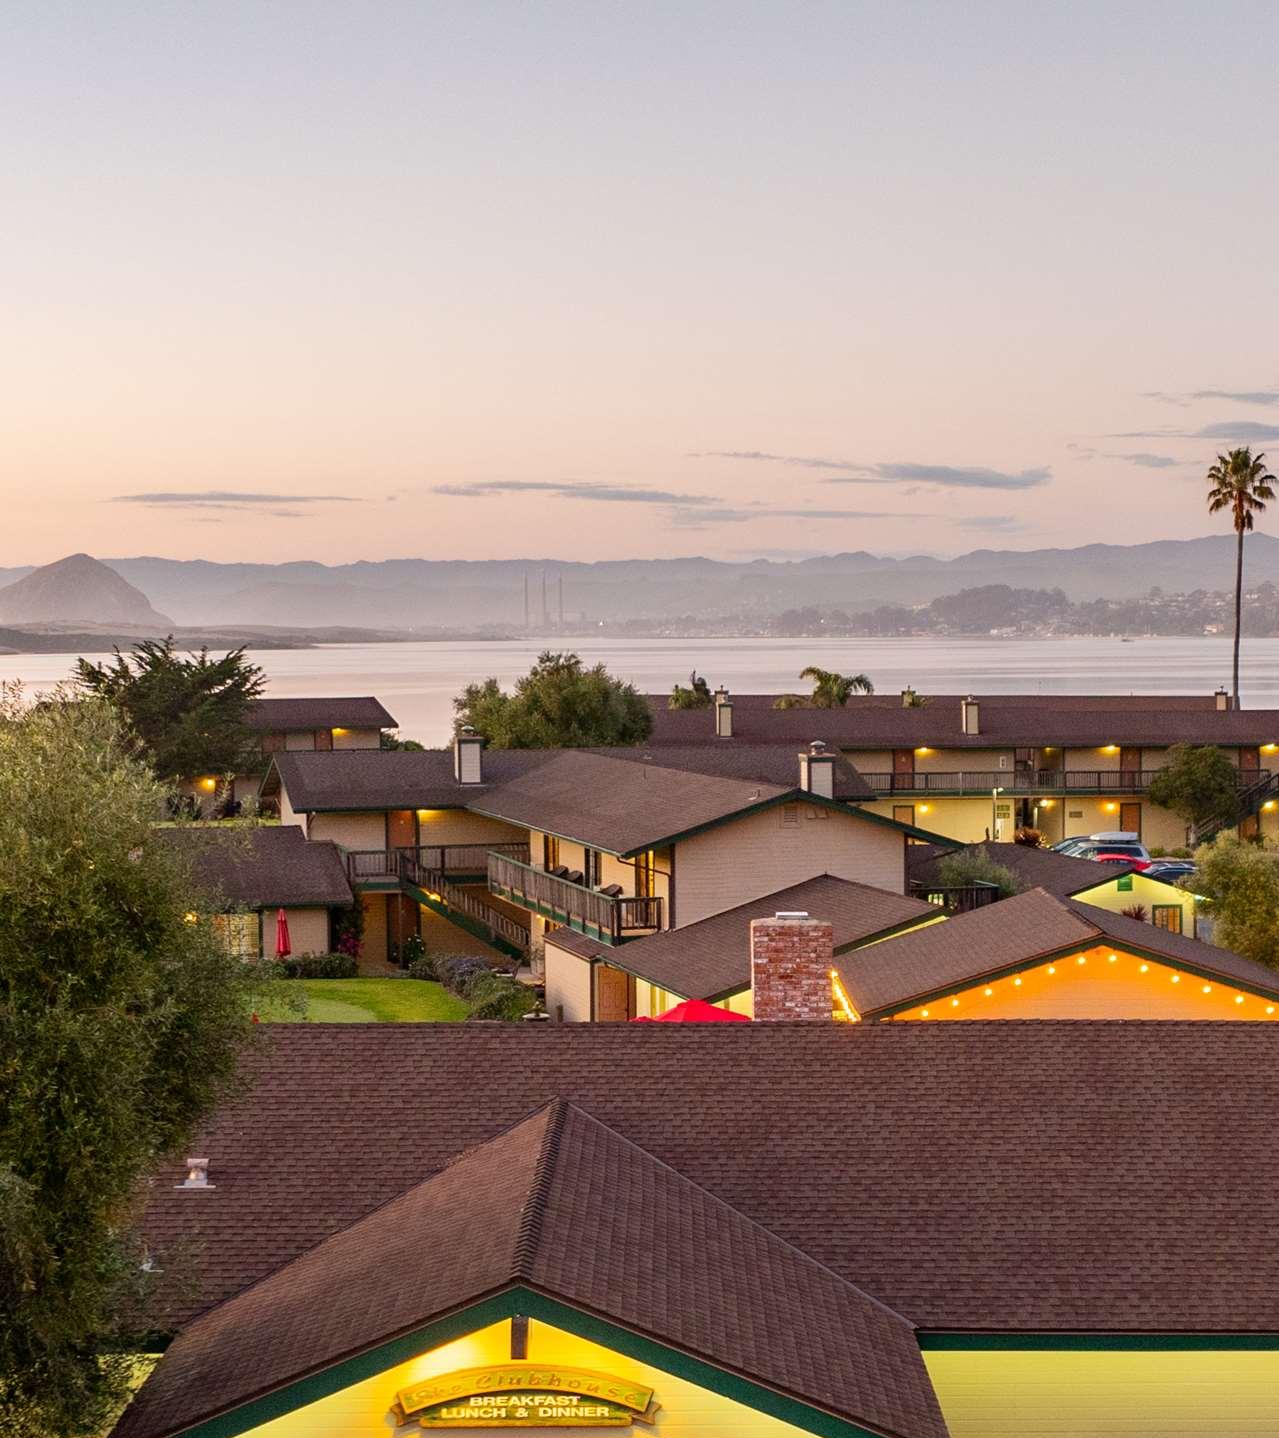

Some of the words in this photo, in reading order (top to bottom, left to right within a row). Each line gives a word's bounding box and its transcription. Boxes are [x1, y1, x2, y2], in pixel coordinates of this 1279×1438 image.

[475, 1372, 638, 1403] Clubhouse
[469, 1396, 581, 1407] BREAKFAST
[440, 1407, 507, 1418] LUNCH
[515, 1408, 529, 1418] &
[538, 1407, 610, 1418] DINNER
